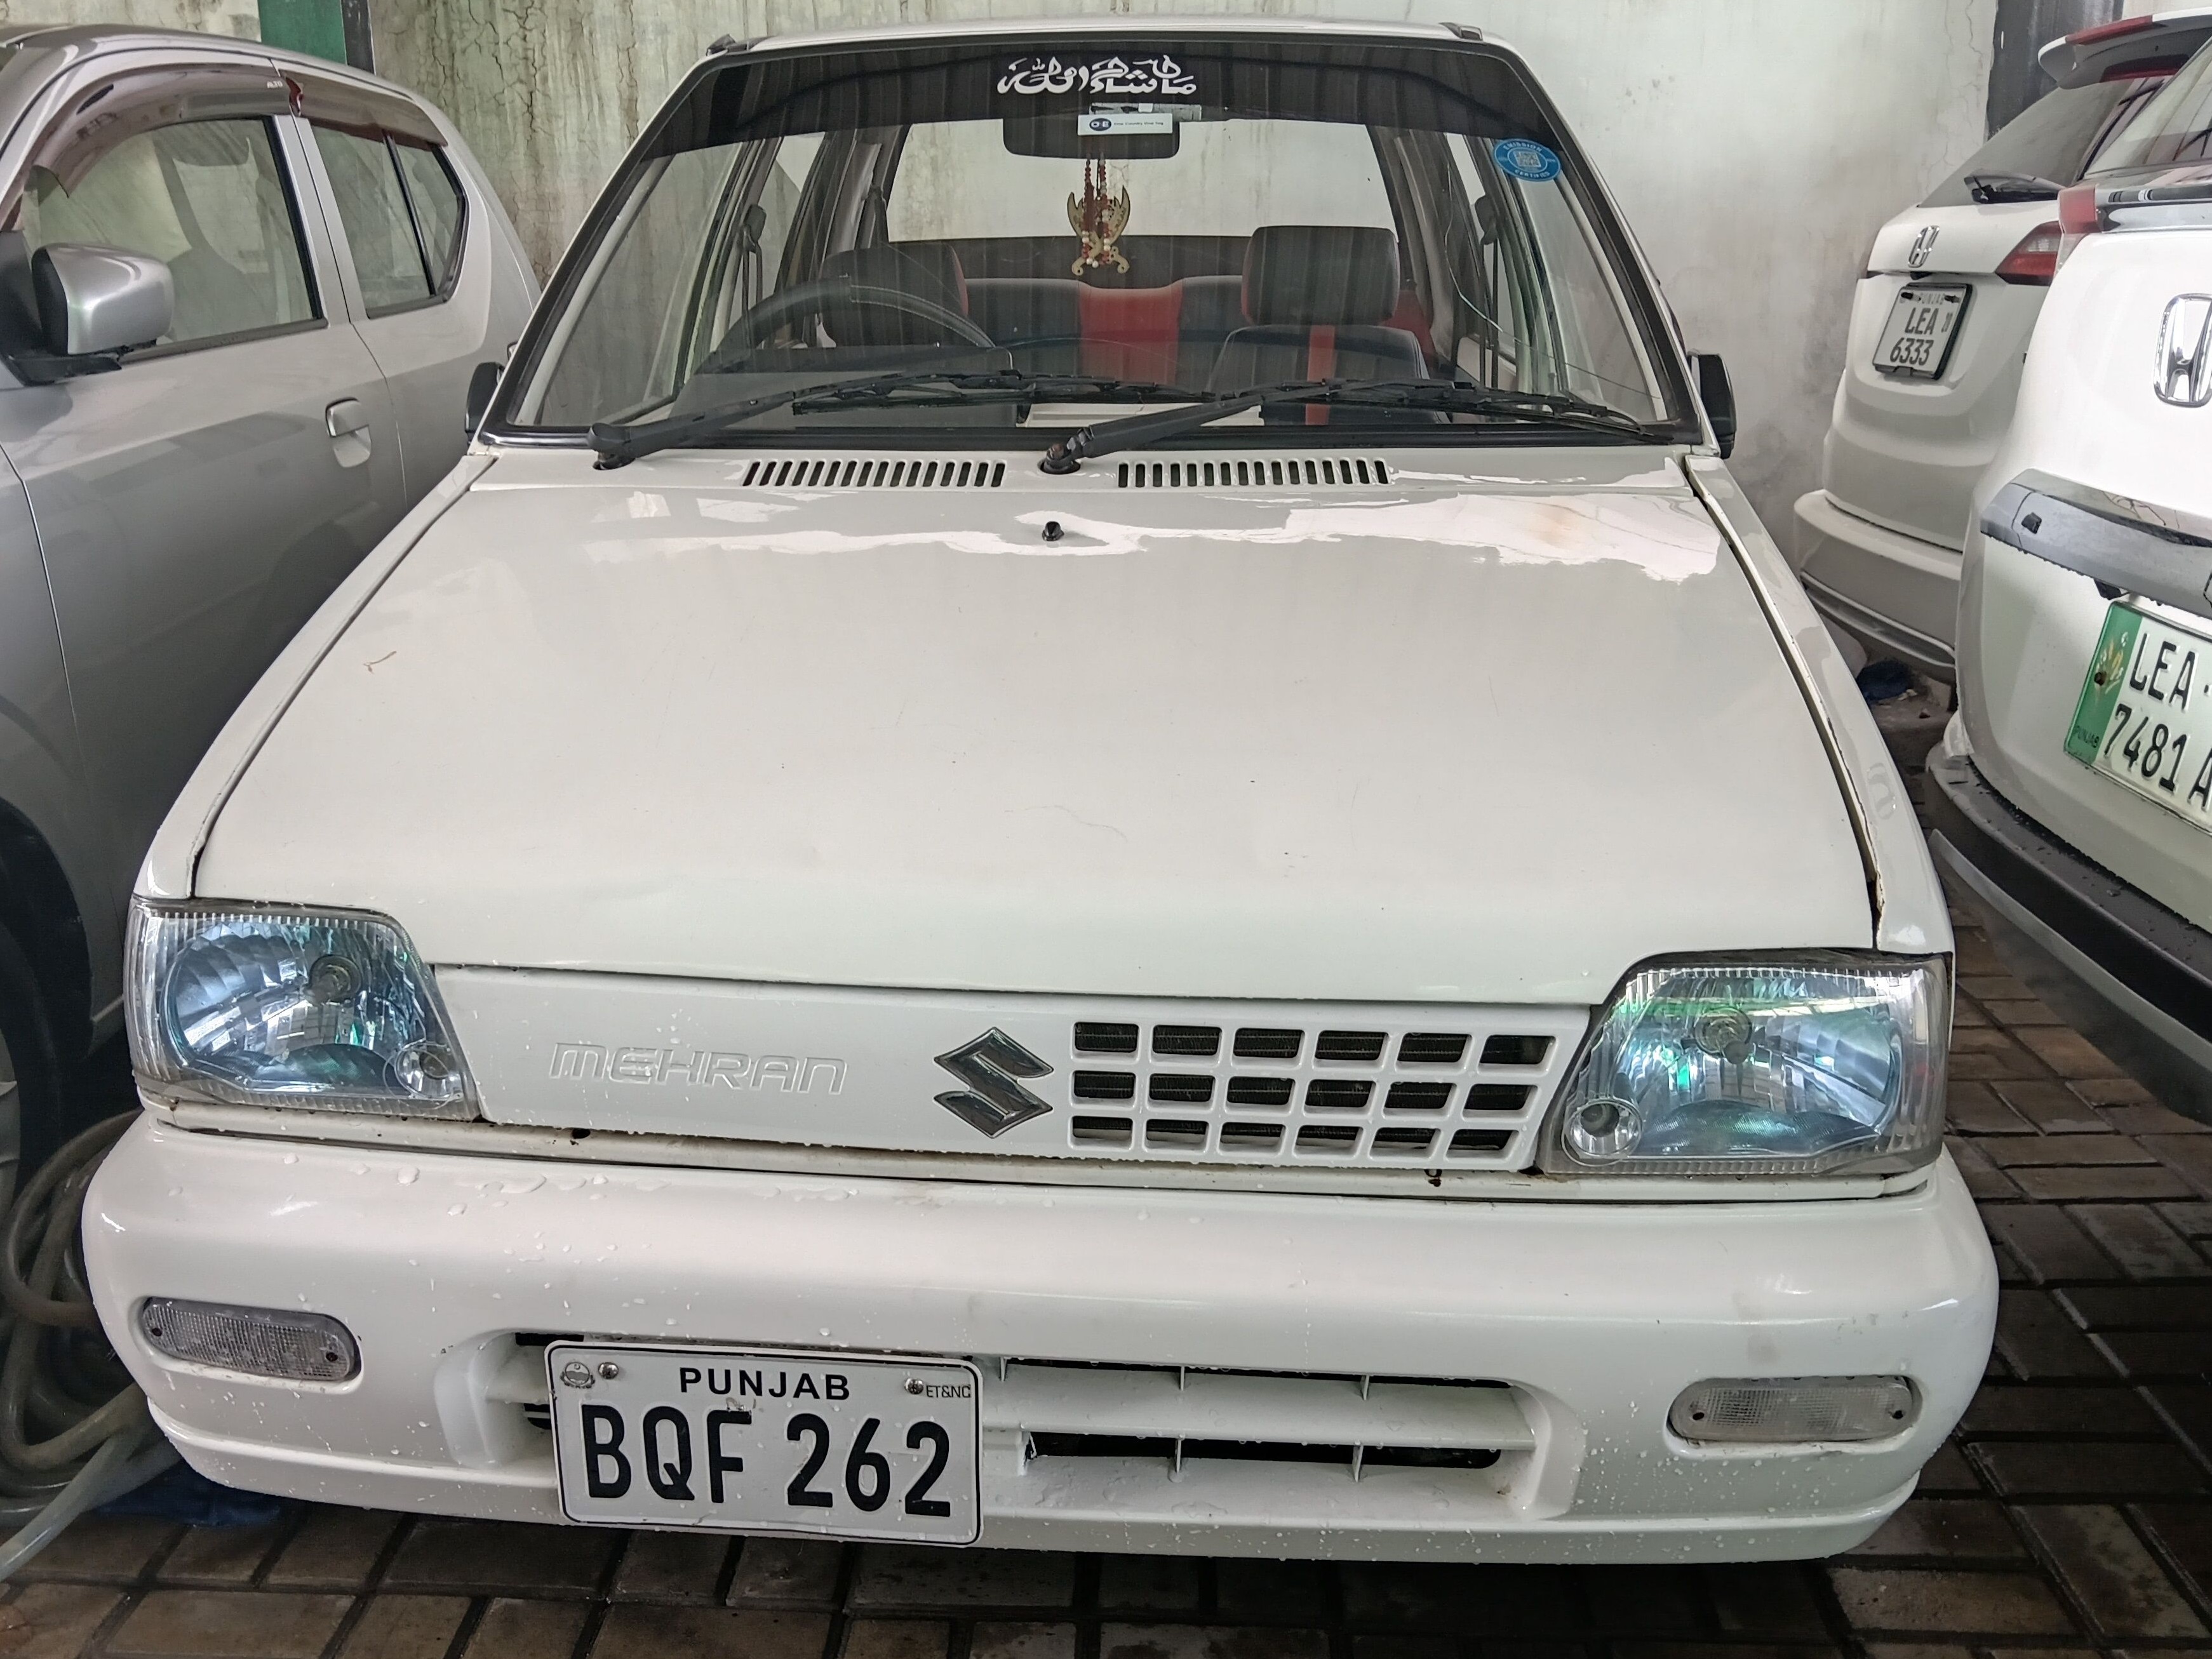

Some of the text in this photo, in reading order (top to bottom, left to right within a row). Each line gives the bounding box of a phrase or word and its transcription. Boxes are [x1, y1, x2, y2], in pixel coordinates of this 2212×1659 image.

[1503, 142, 1543, 152] EMISSION
[1515, 169, 1550, 178] CERTIFIED
[1904, 307, 1939, 335] LEA
[1890, 336, 1934, 366] 6333
[2103, 703, 2189, 792] 7481
[549, 1041, 848, 1096] MEHRAN
[680, 1366, 850, 1401] PUNJAB
[926, 1385, 971, 1398] ET&NC
[580, 1403, 951, 1517] BQF 262
